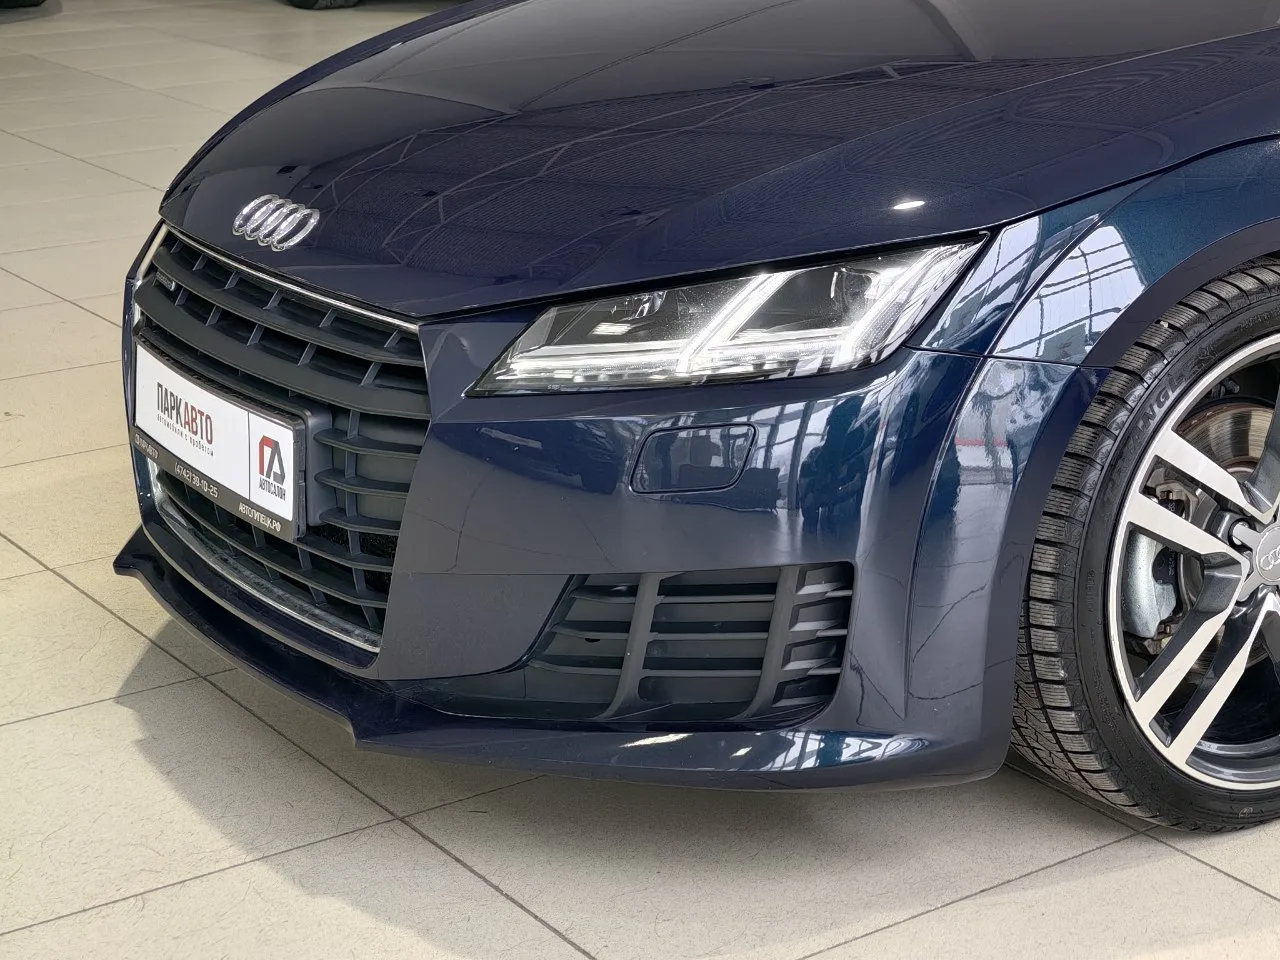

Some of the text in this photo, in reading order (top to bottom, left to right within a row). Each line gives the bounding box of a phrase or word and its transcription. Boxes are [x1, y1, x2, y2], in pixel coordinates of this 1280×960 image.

[157, 381, 213, 445] ПАРКАВТО
[175, 462, 218, 498] (4742) 39-10-25
